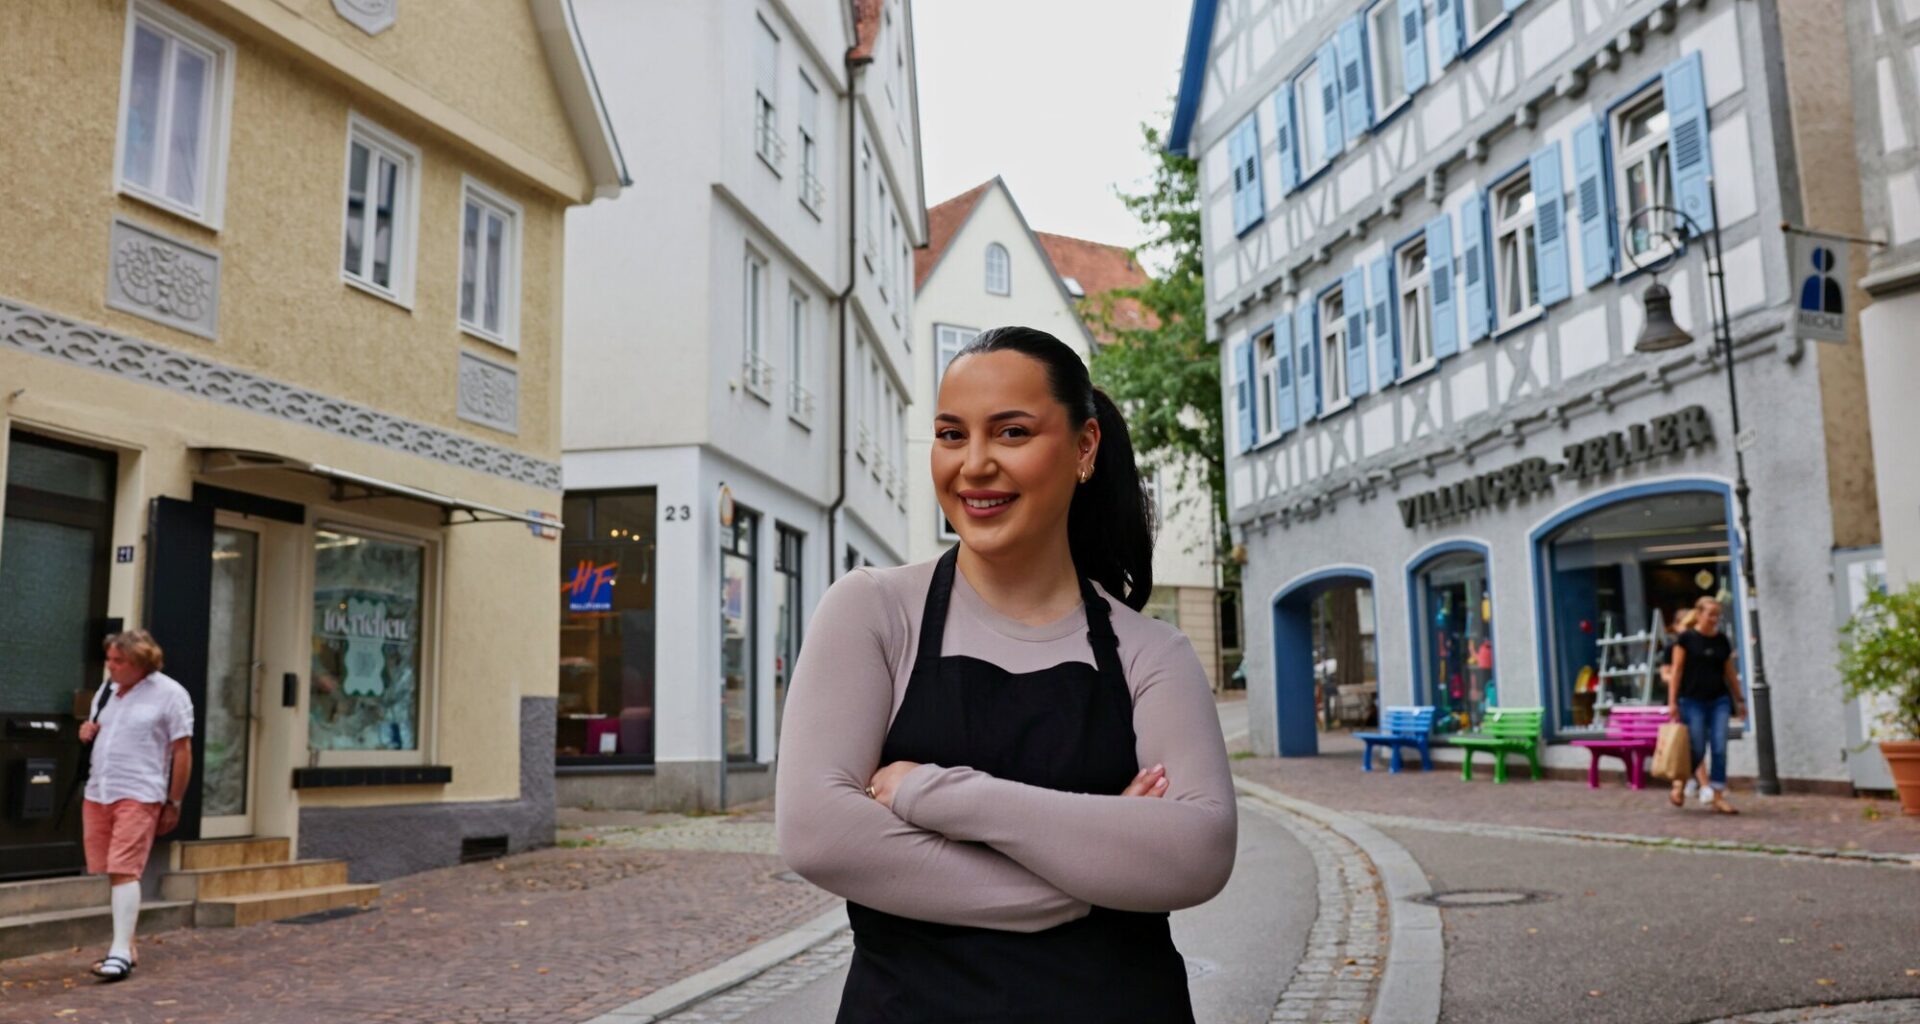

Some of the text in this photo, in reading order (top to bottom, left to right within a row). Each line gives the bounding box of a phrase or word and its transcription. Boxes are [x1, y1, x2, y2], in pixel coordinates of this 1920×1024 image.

[1399, 404, 1714, 528] VILLINGER-ZELLER
[665, 505, 690, 521] 23
[560, 560, 617, 602] HF
